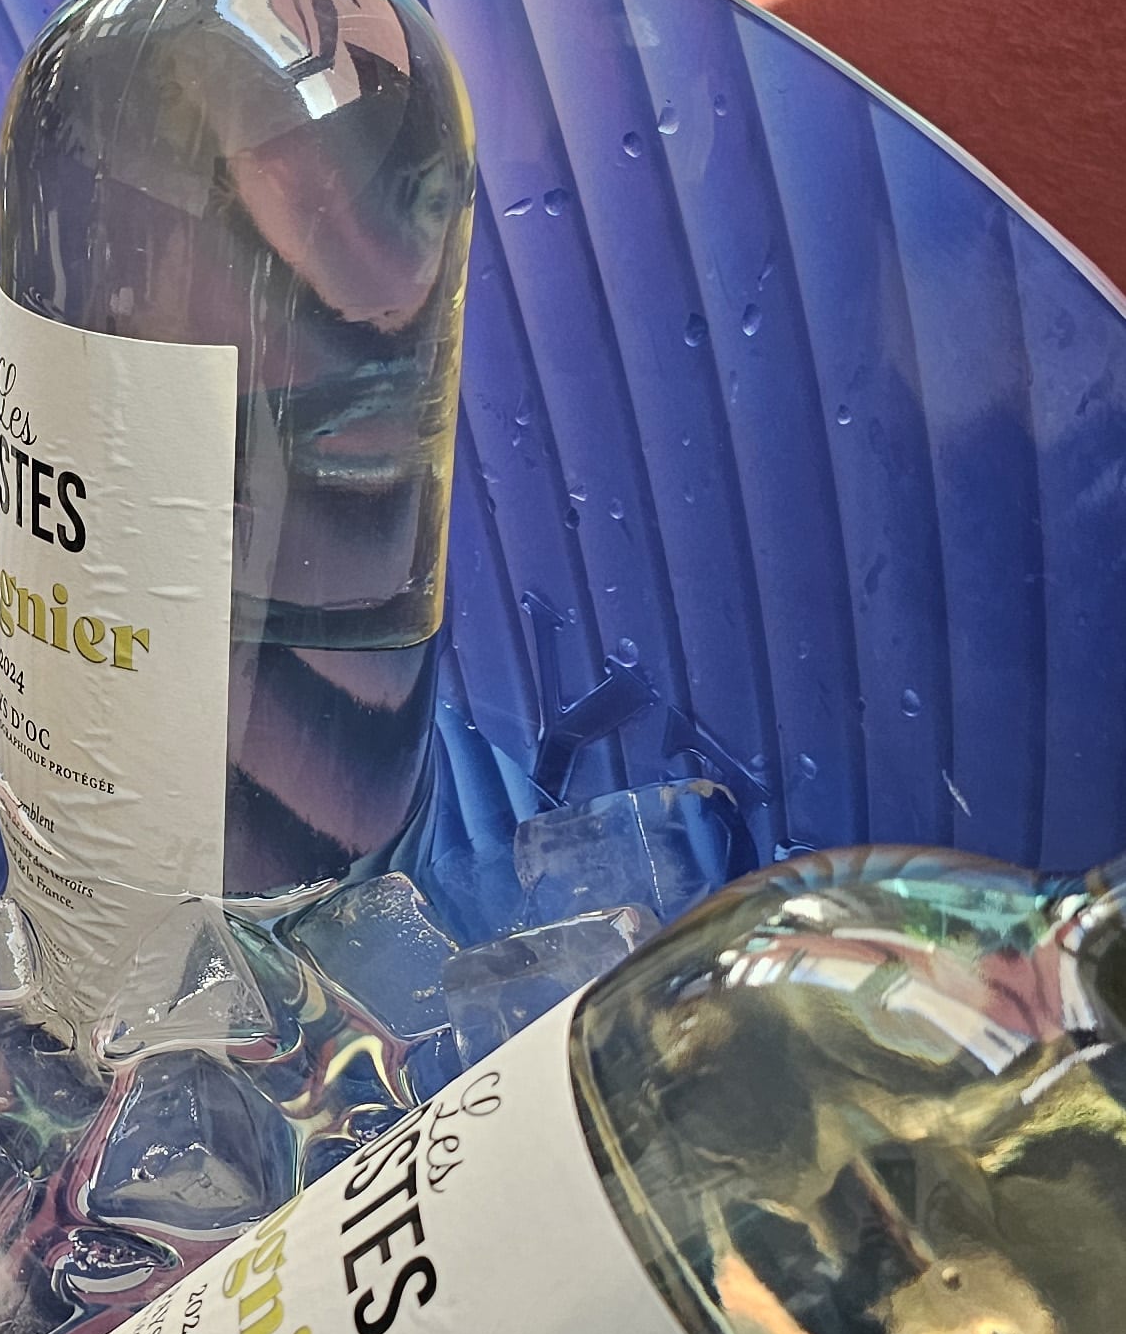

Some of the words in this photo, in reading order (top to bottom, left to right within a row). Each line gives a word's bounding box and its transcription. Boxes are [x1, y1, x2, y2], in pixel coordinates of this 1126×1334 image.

[0, 648, 25, 695] 2024
[49, 761, 115, 795] PROTÉGÉE
[425, 1071, 502, 1194] Les
